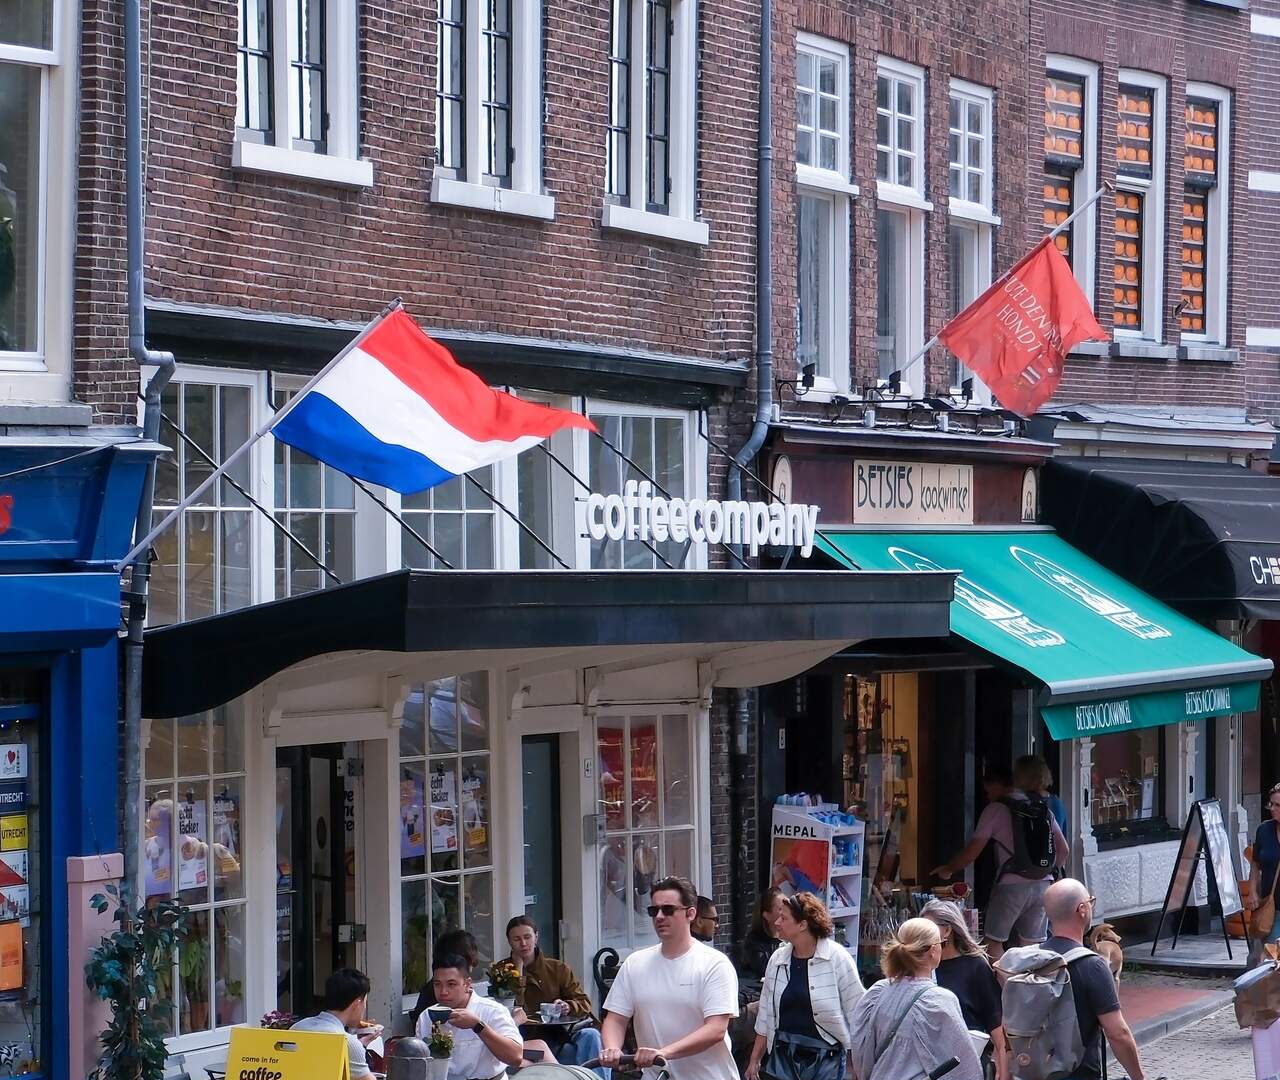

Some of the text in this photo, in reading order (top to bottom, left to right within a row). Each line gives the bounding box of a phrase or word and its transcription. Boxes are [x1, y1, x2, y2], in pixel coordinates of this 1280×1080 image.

[996, 303, 1043, 353] HONDT
[1019, 294, 1052, 330] DEN
[857, 464, 914, 509] BETSIES
[586, 479, 821, 559] coffeecompany
[1, 828, 26, 840] UTRECHT
[773, 824, 817, 838] MEPAL
[241, 1055, 279, 1064] come in for
